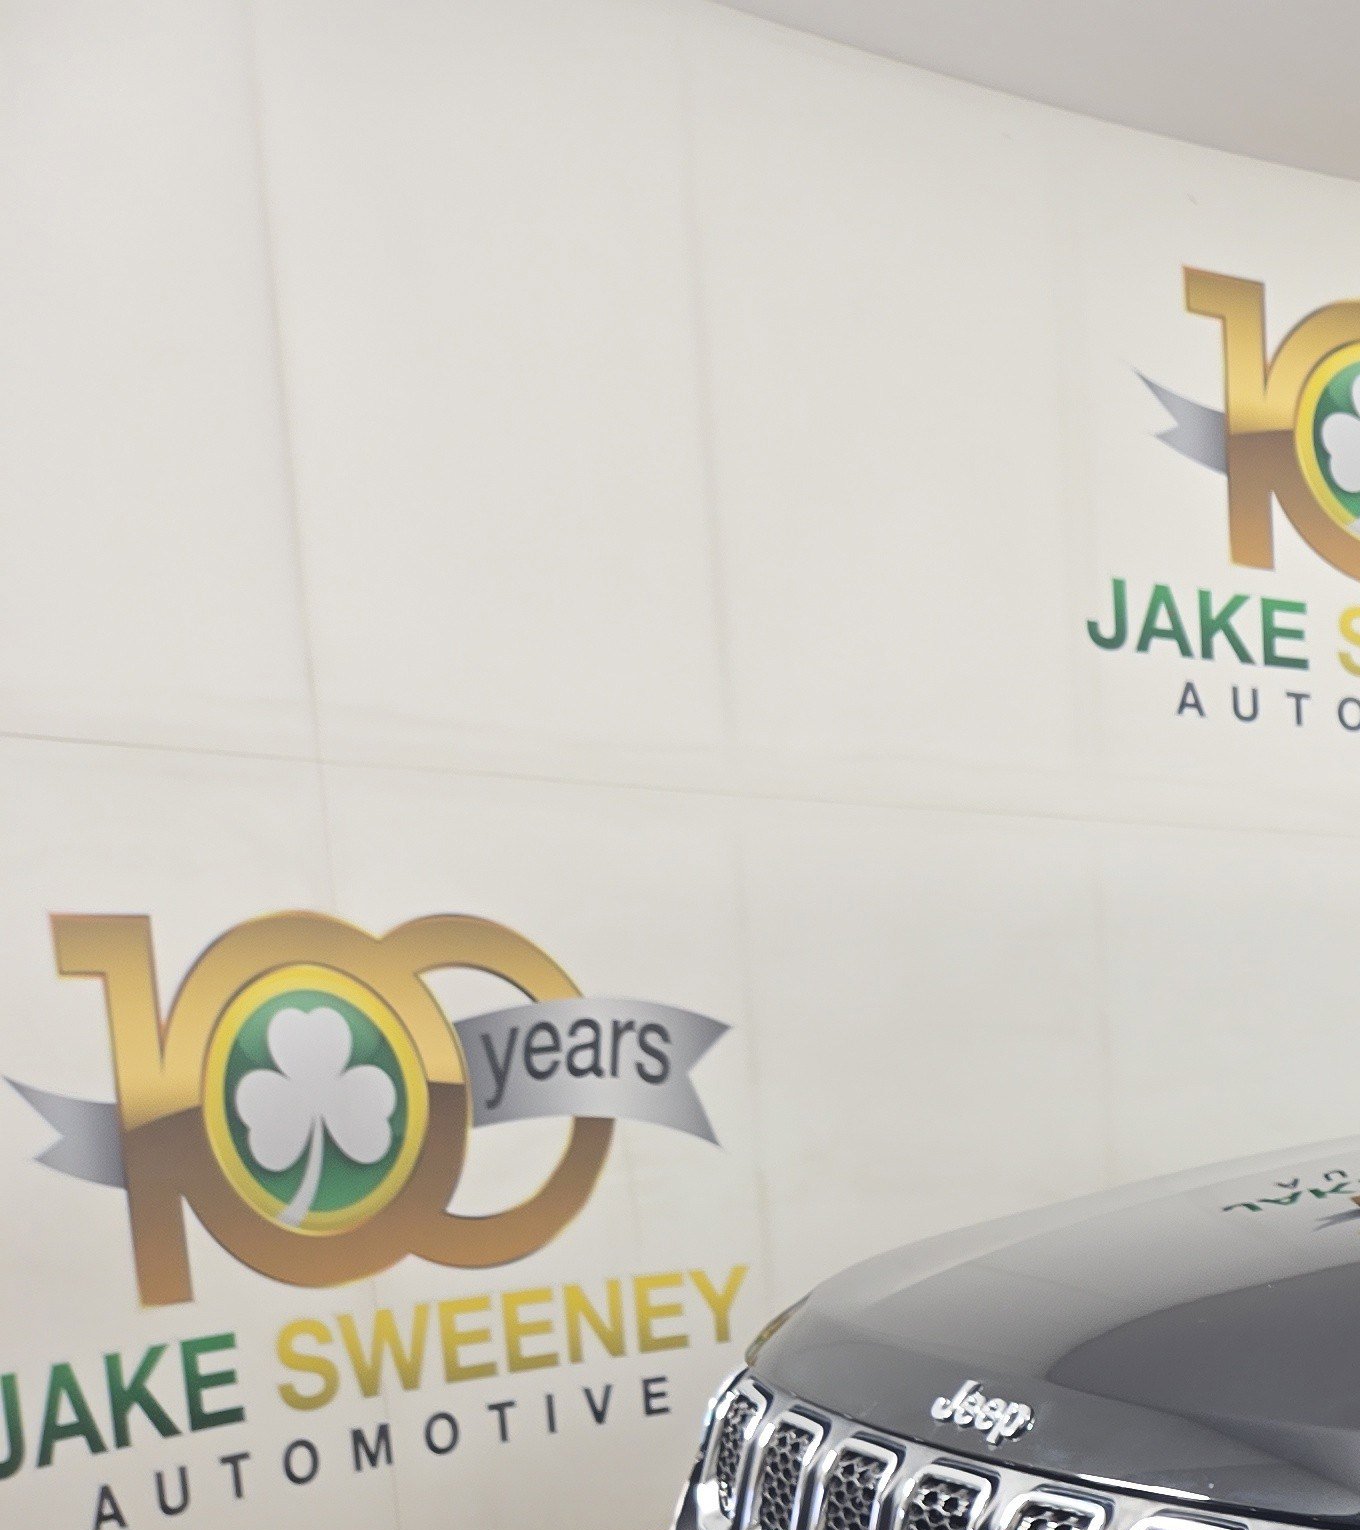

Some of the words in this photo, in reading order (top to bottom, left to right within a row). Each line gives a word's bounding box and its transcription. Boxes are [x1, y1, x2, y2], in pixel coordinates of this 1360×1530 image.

[1086, 576, 1310, 671] JAKE
[480, 1018, 672, 1108] years
[274, 1265, 748, 1412] SWEENEY
[930, 1379, 1032, 1444] Jeep
